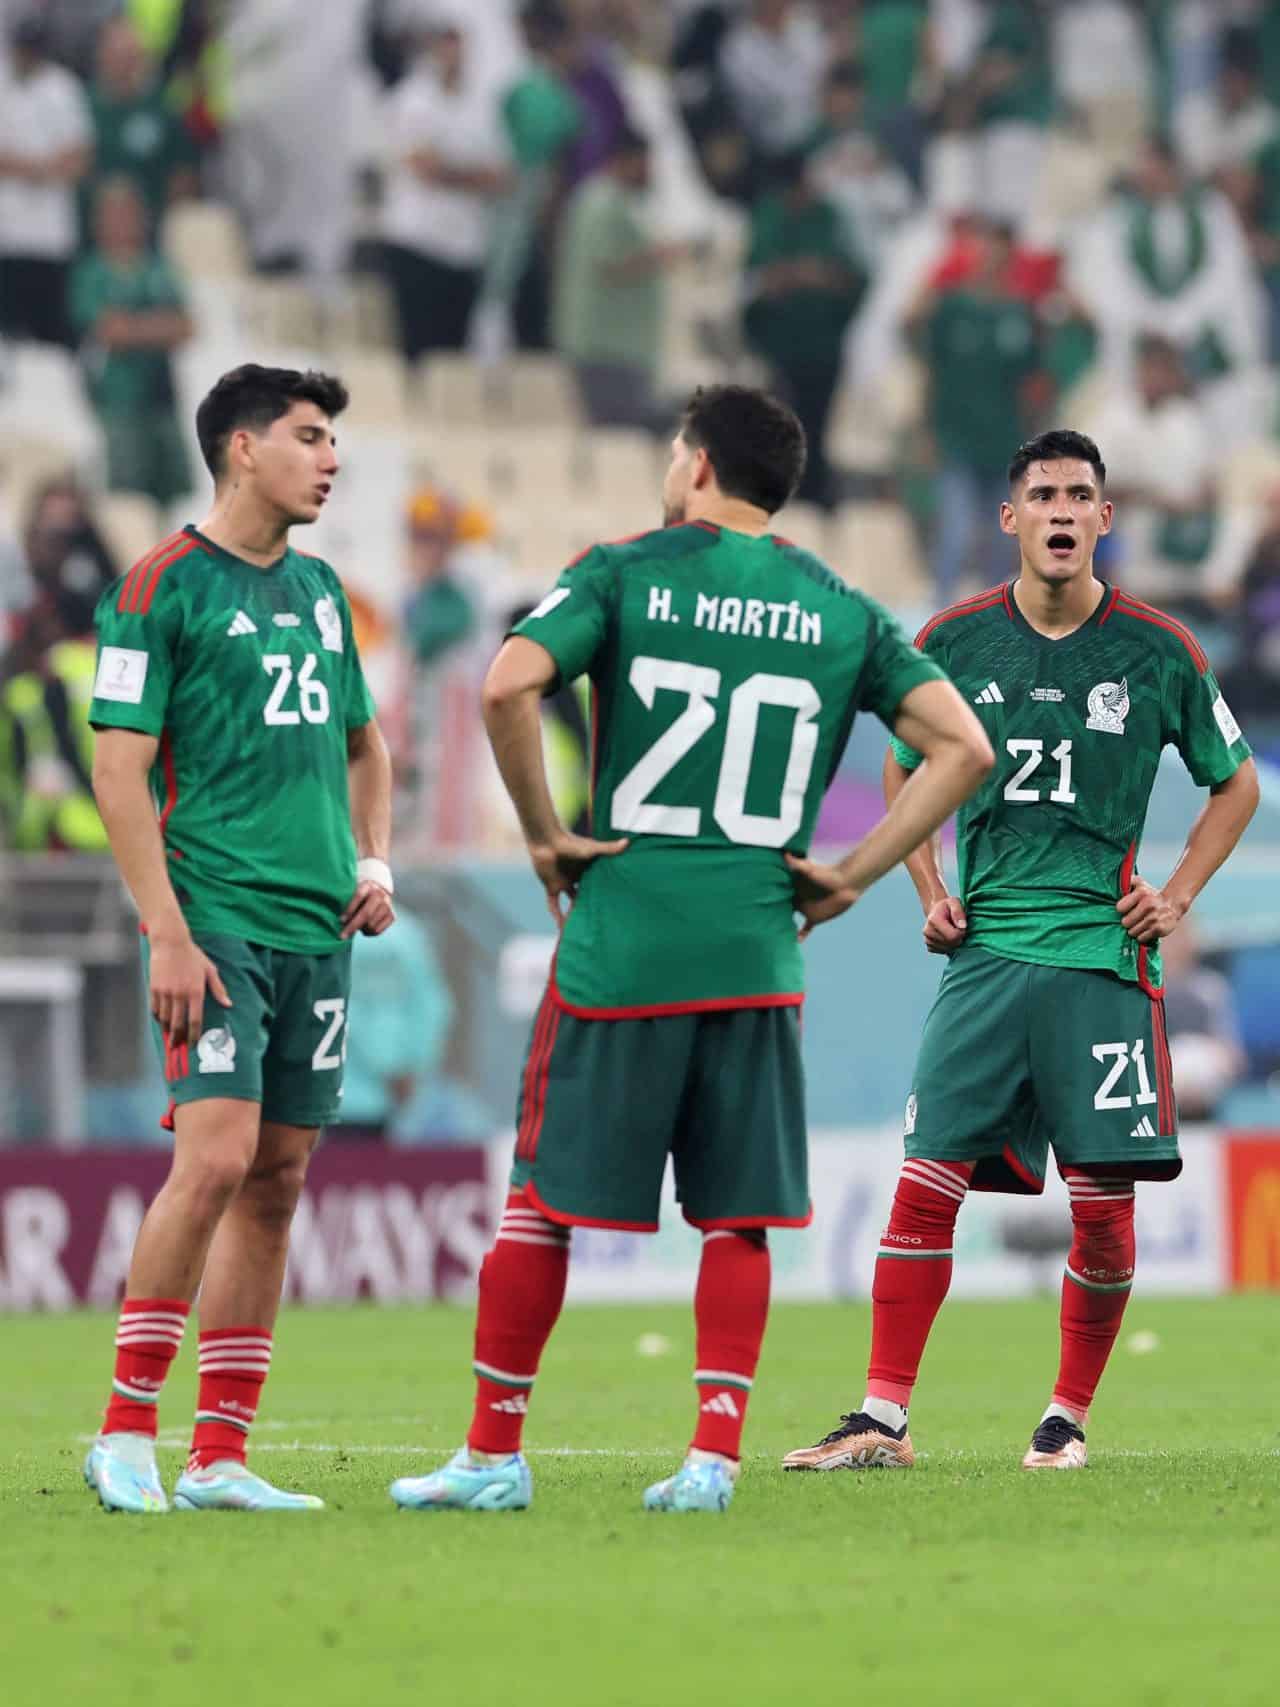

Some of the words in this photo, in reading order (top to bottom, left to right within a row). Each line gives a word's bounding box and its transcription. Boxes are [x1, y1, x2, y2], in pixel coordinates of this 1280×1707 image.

[647, 586, 680, 623] H.
[693, 590, 822, 645] MARTÍN
[261, 653, 330, 726] 26
[610, 655, 823, 849] 20
[1003, 738, 1078, 804] 21
[312, 997, 349, 1071] 2
[1091, 1038, 1158, 1111] 21
